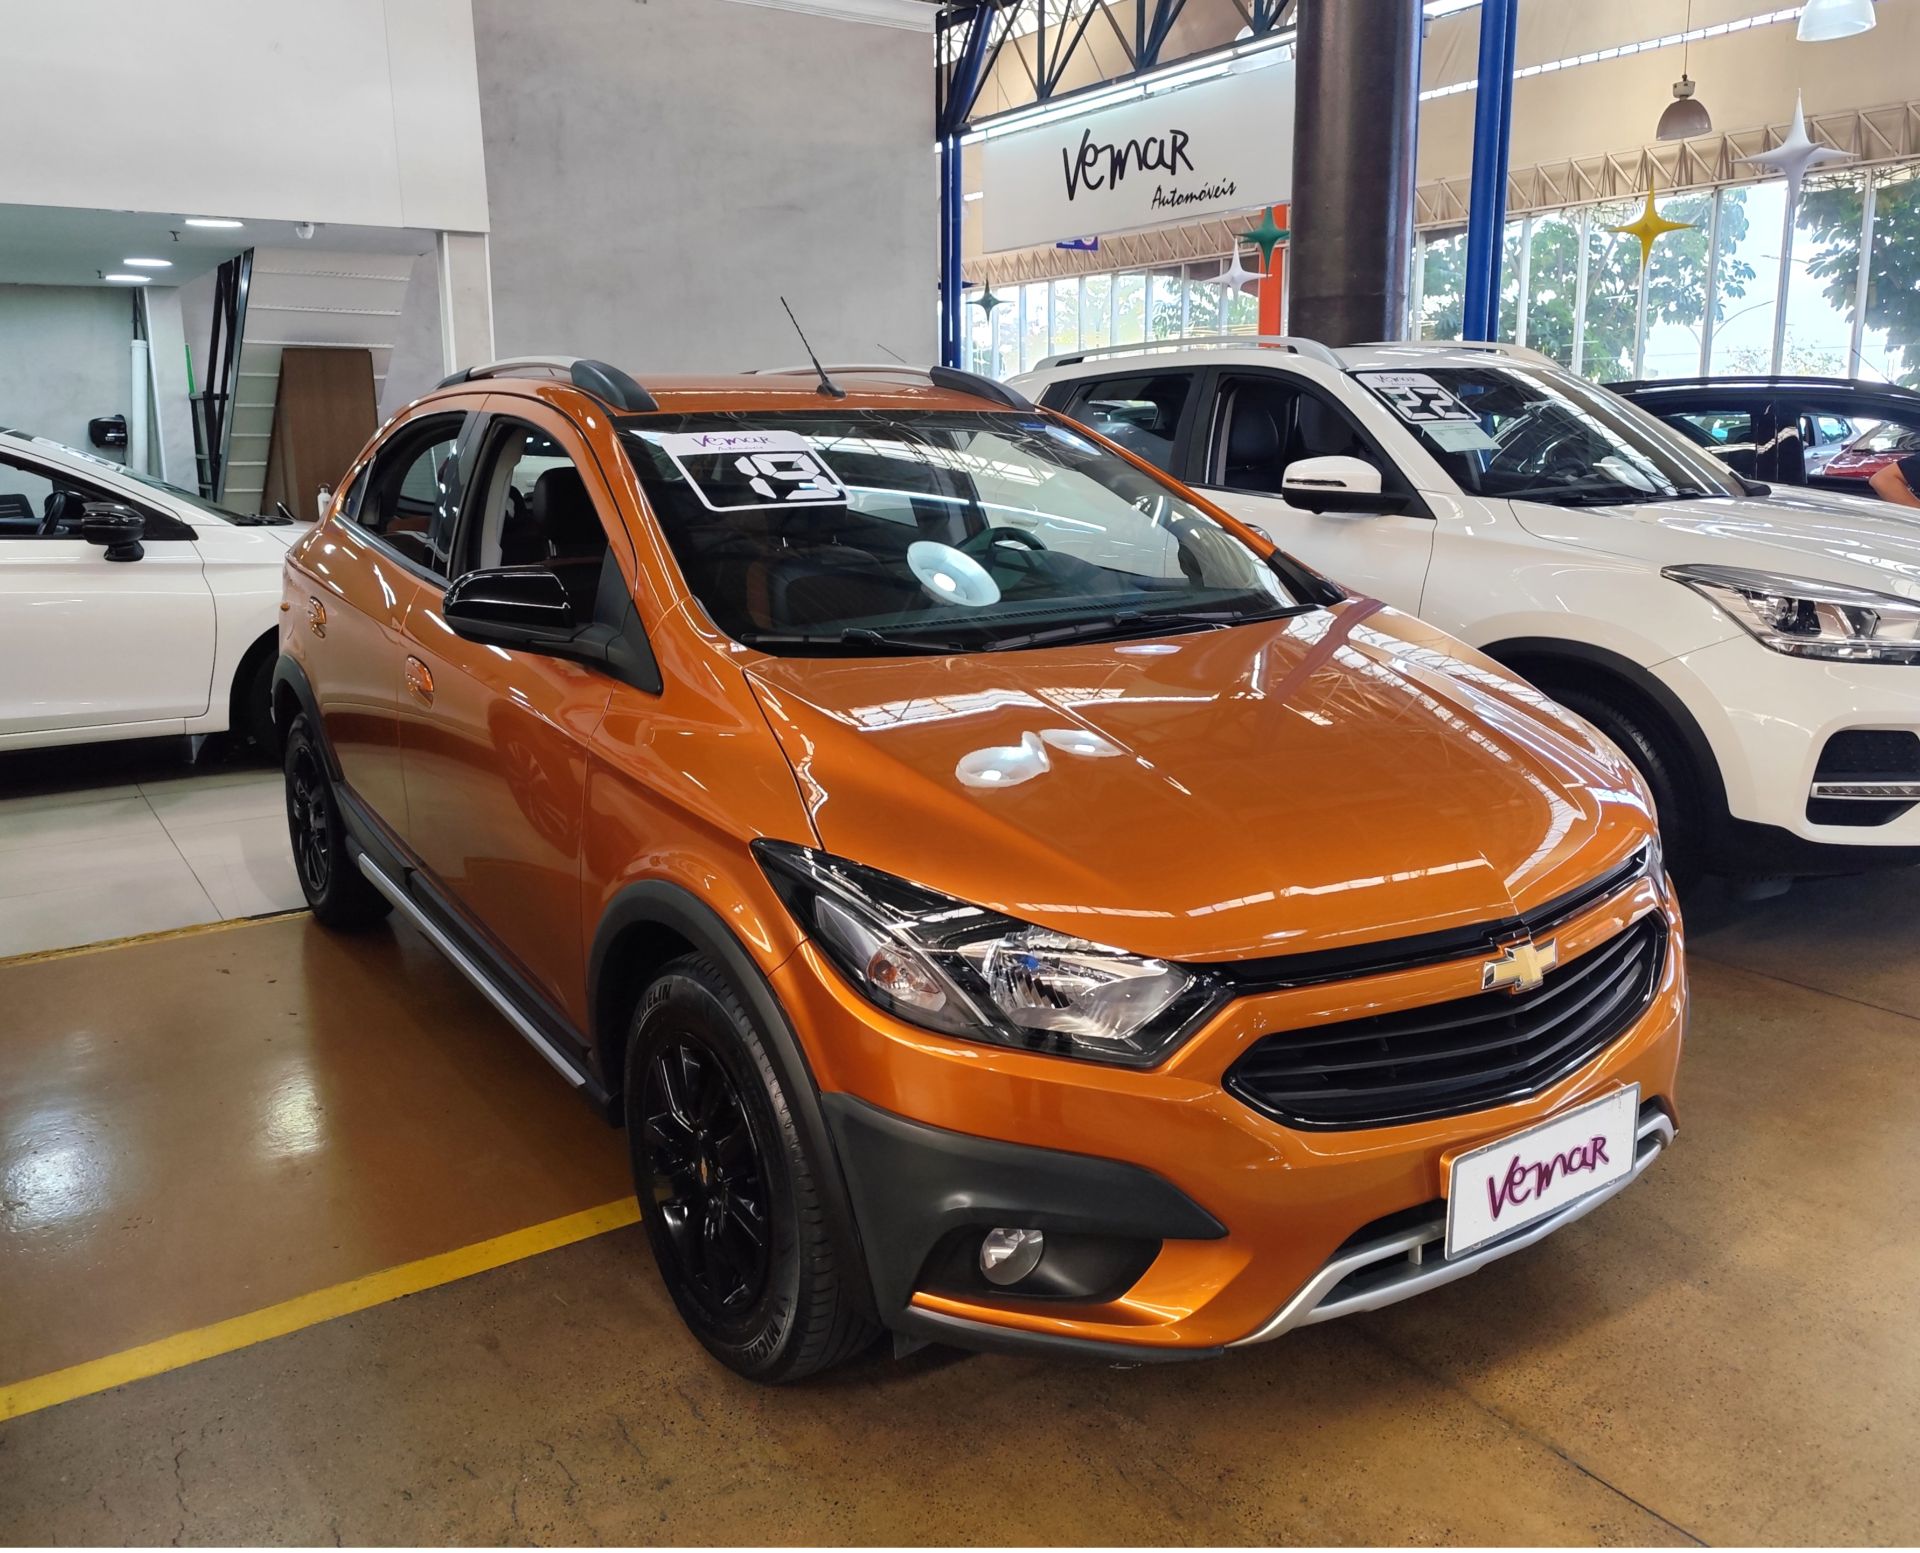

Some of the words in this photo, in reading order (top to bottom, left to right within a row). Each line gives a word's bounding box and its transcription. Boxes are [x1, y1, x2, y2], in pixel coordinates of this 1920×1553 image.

[1151, 177, 1237, 210] Automóveis
[1380, 386, 1472, 420] 22
[734, 453, 841, 500] 19
